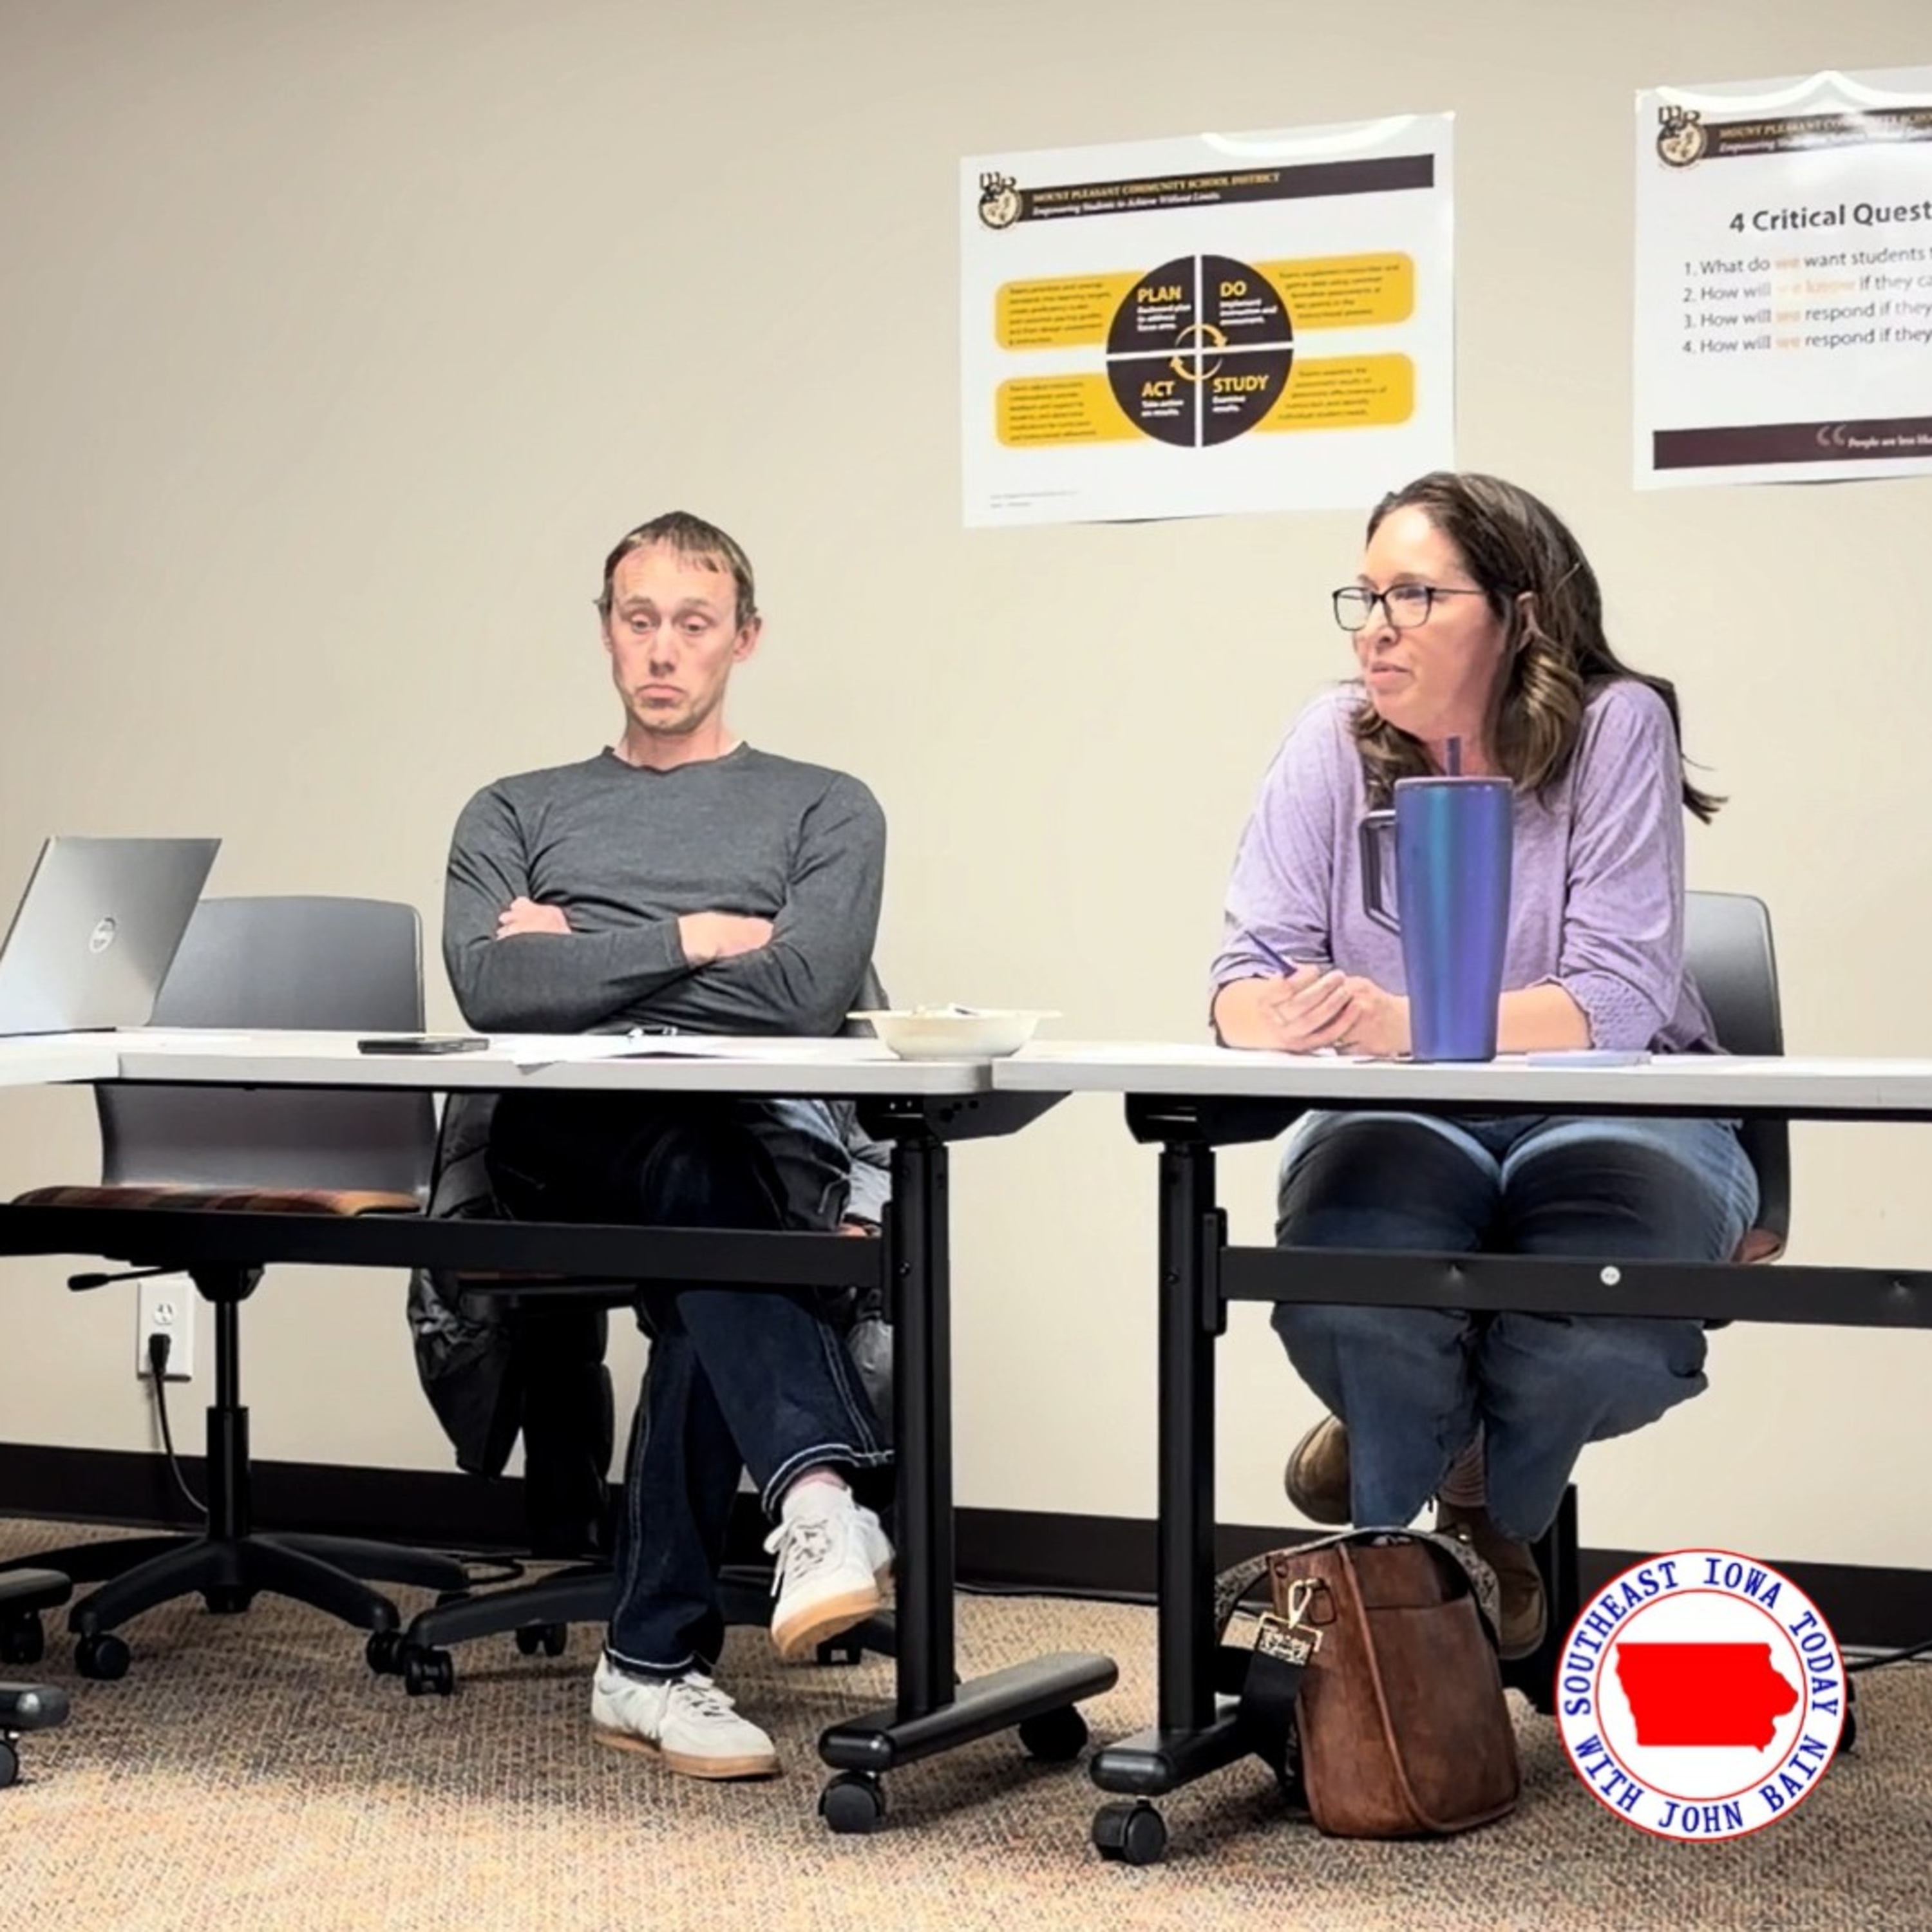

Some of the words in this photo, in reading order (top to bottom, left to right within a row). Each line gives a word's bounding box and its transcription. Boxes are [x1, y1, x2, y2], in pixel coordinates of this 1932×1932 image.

[1729, 213, 1745, 233] 4
[1752, 204, 1845, 232] Critical
[1853, 201, 1932, 226] Quest
[1685, 261, 1698, 277] 1.
[1700, 260, 1743, 275] What
[1747, 257, 1770, 272] do
[1804, 252, 1846, 267] want
[1852, 247, 1926, 265] students
[1137, 285, 1182, 303] PLAN
[1220, 281, 1246, 298] DO
[1683, 287, 1697, 303] 2.
[1701, 287, 1739, 300] How
[1743, 281, 1771, 298] will
[1860, 275, 1871, 290] if
[1875, 274, 1913, 292] they
[1701, 313, 1738, 327] How
[1743, 309, 1771, 323] will
[1805, 303, 1875, 322] respond
[1880, 301, 1891, 316] if
[1895, 300, 1932, 317] they
[1701, 339, 1739, 353] How
[1743, 334, 1771, 350] will
[1805, 328, 1875, 350] respond
[1880, 327, 1891, 342] if
[1895, 327, 1932, 345] they
[1142, 381, 1175, 397] ACT
[1213, 374, 1269, 393] STUDY
